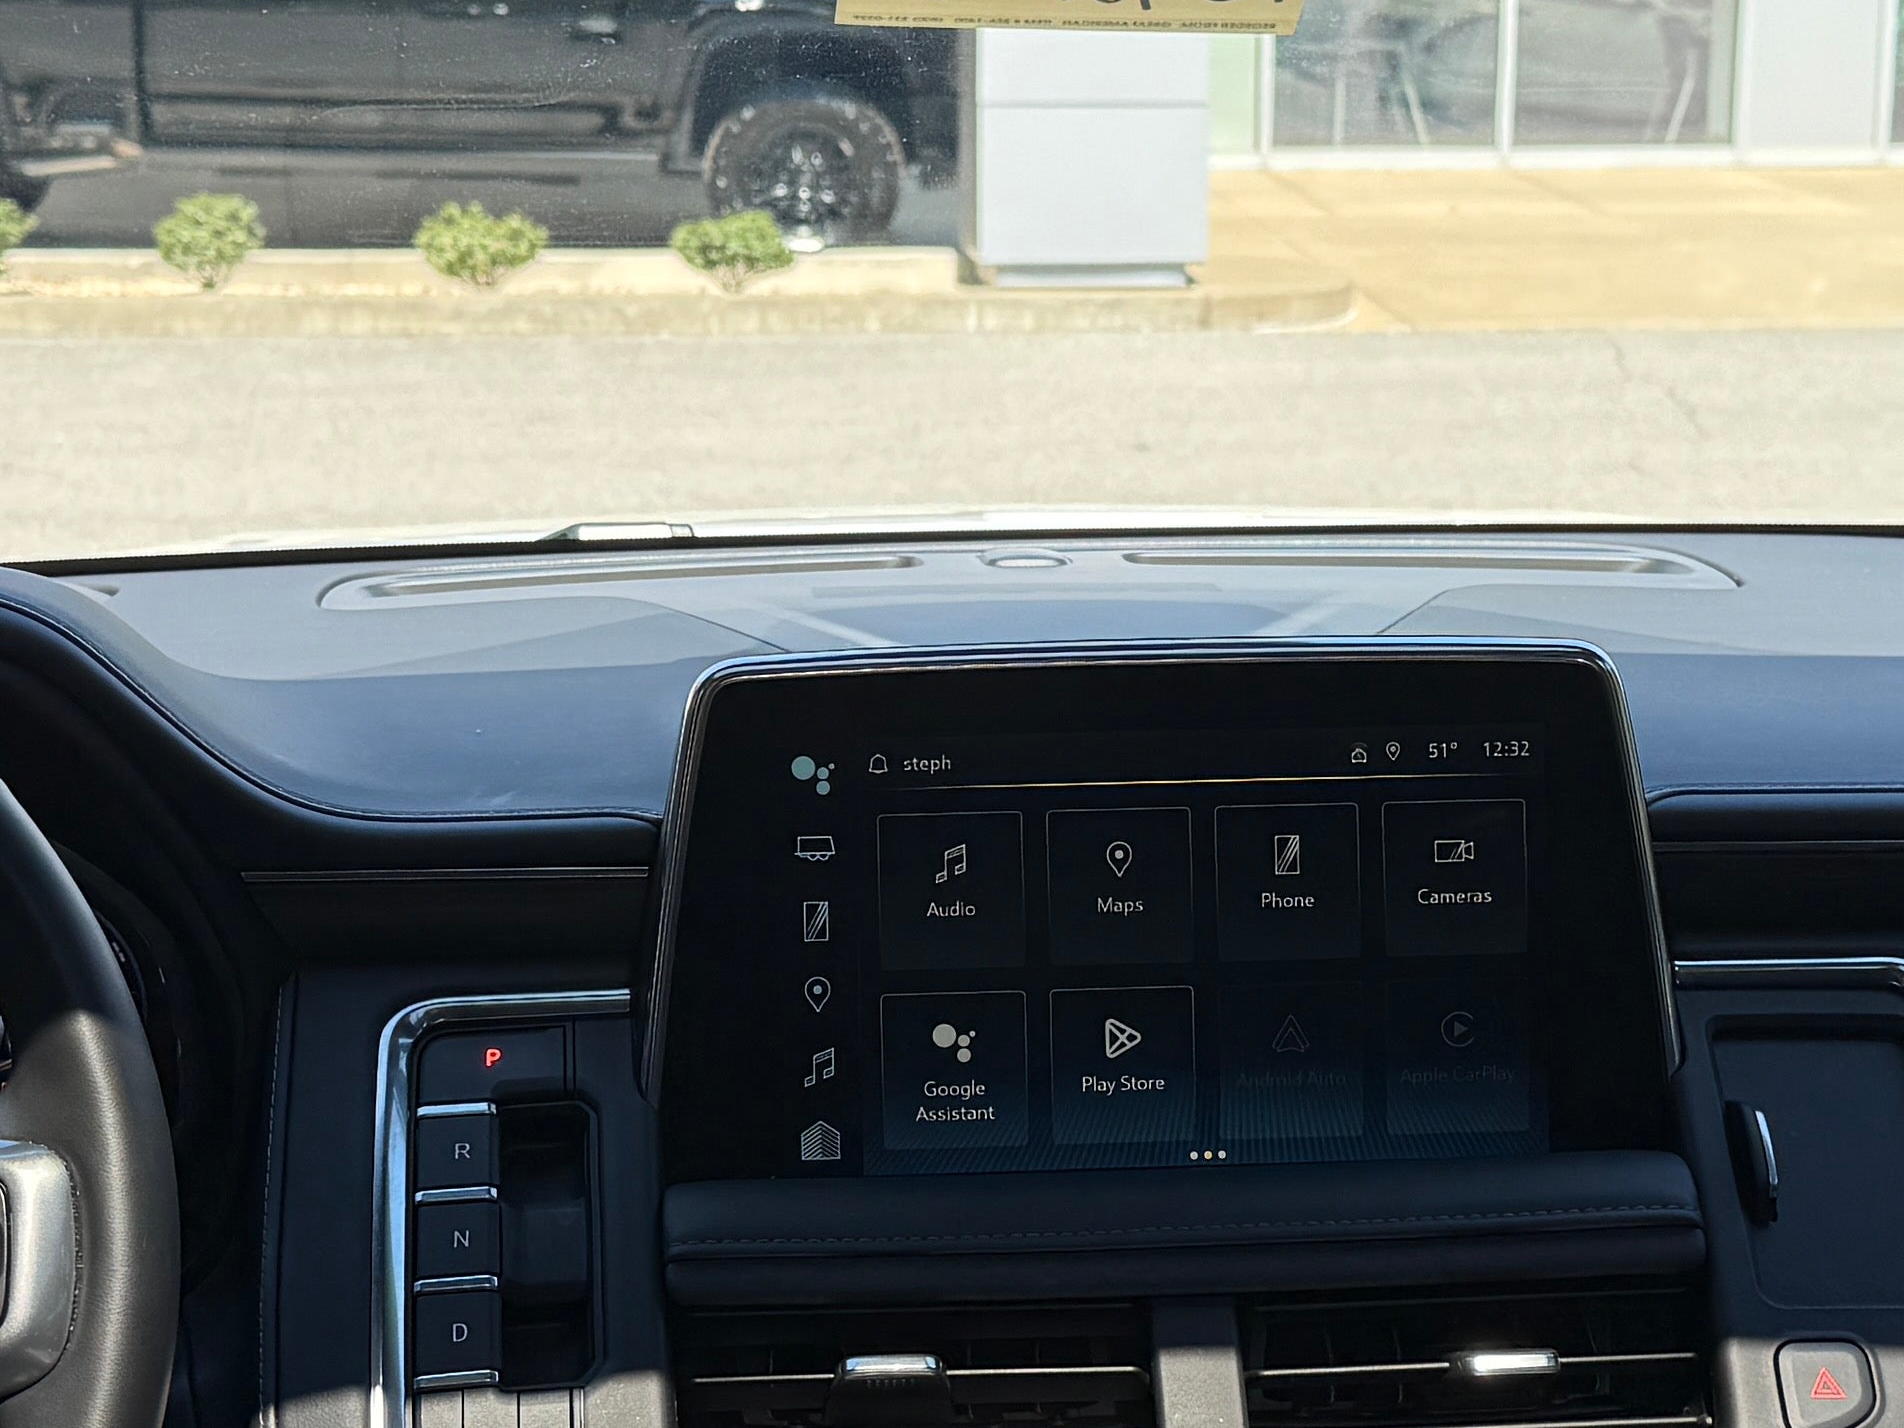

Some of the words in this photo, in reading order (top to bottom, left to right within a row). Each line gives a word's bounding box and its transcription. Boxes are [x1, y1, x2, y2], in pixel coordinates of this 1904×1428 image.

[1428, 743, 1458, 760] 51°
[1483, 741, 1531, 759] 12:32
[903, 753, 952, 775] steph
[1260, 892, 1315, 910] Phone
[1416, 887, 1493, 906] Cameras
[927, 900, 977, 919] Audio
[1096, 896, 1145, 917] Maps
[485, 1048, 501, 1066] P
[1081, 1073, 1117, 1095] Play
[1122, 1072, 1166, 1093] Store
[1399, 1067, 1448, 1085] Apple
[1453, 1064, 1518, 1082] CarPlay
[923, 1080, 986, 1101] Google
[915, 1103, 995, 1123] Assistant
[454, 1142, 471, 1160] R
[453, 1230, 470, 1248] N
[451, 1323, 468, 1343] D
